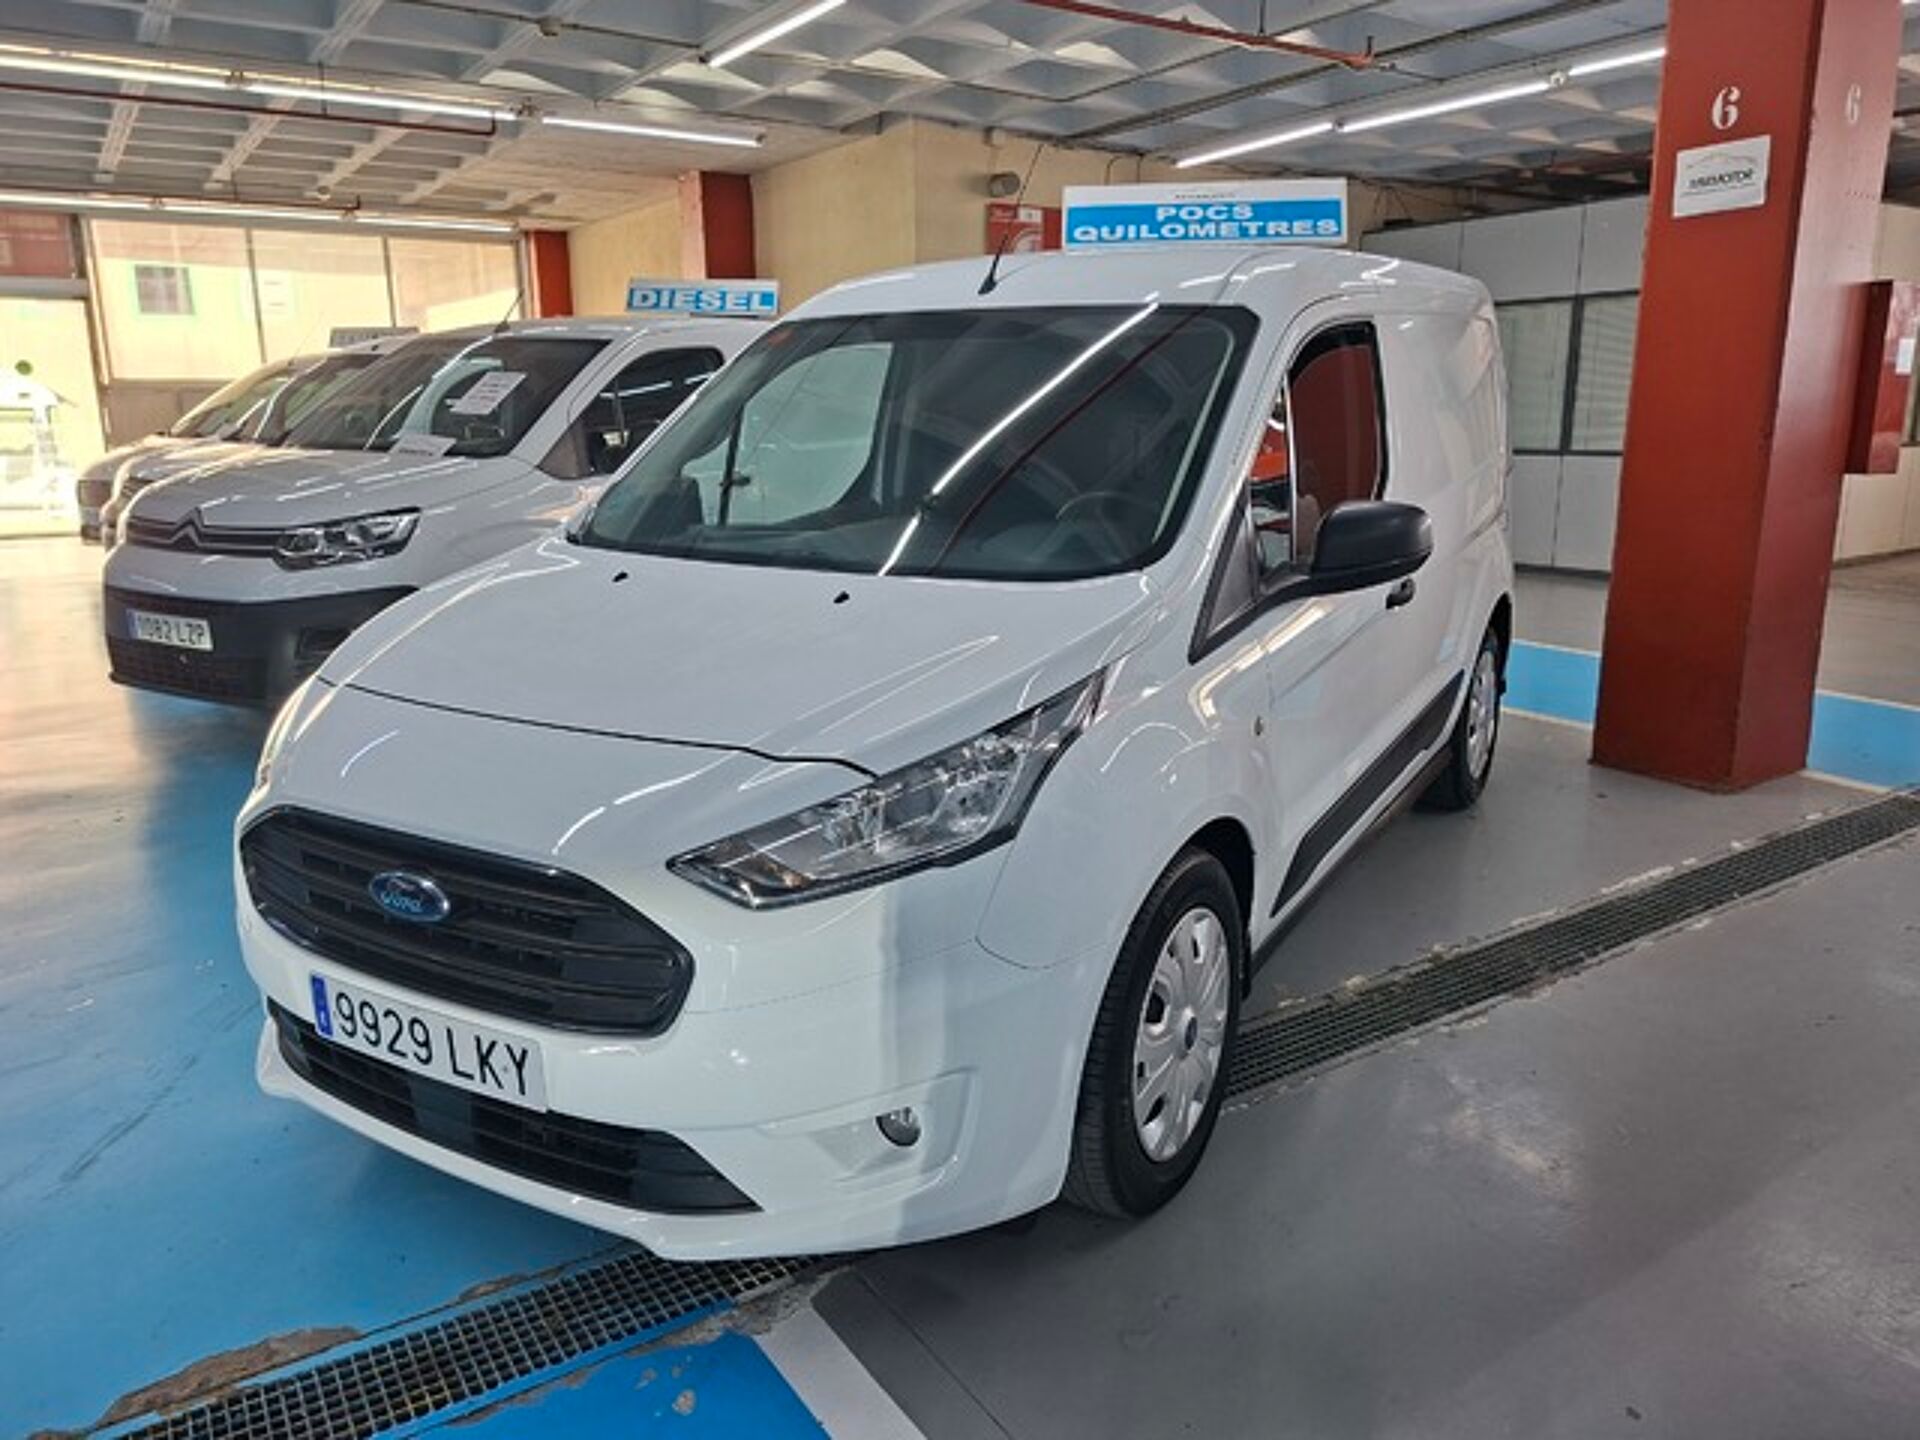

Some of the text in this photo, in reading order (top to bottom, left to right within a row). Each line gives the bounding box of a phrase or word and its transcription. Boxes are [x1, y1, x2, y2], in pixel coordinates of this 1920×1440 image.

[1711, 85, 1741, 130] 6
[1845, 83, 1862, 125] 6
[1156, 204, 1254, 221] POCS
[1073, 218, 1339, 242] QUILOMETRES
[631, 287, 774, 312] DIESEL
[335, 991, 529, 1096] 9929 LKY
